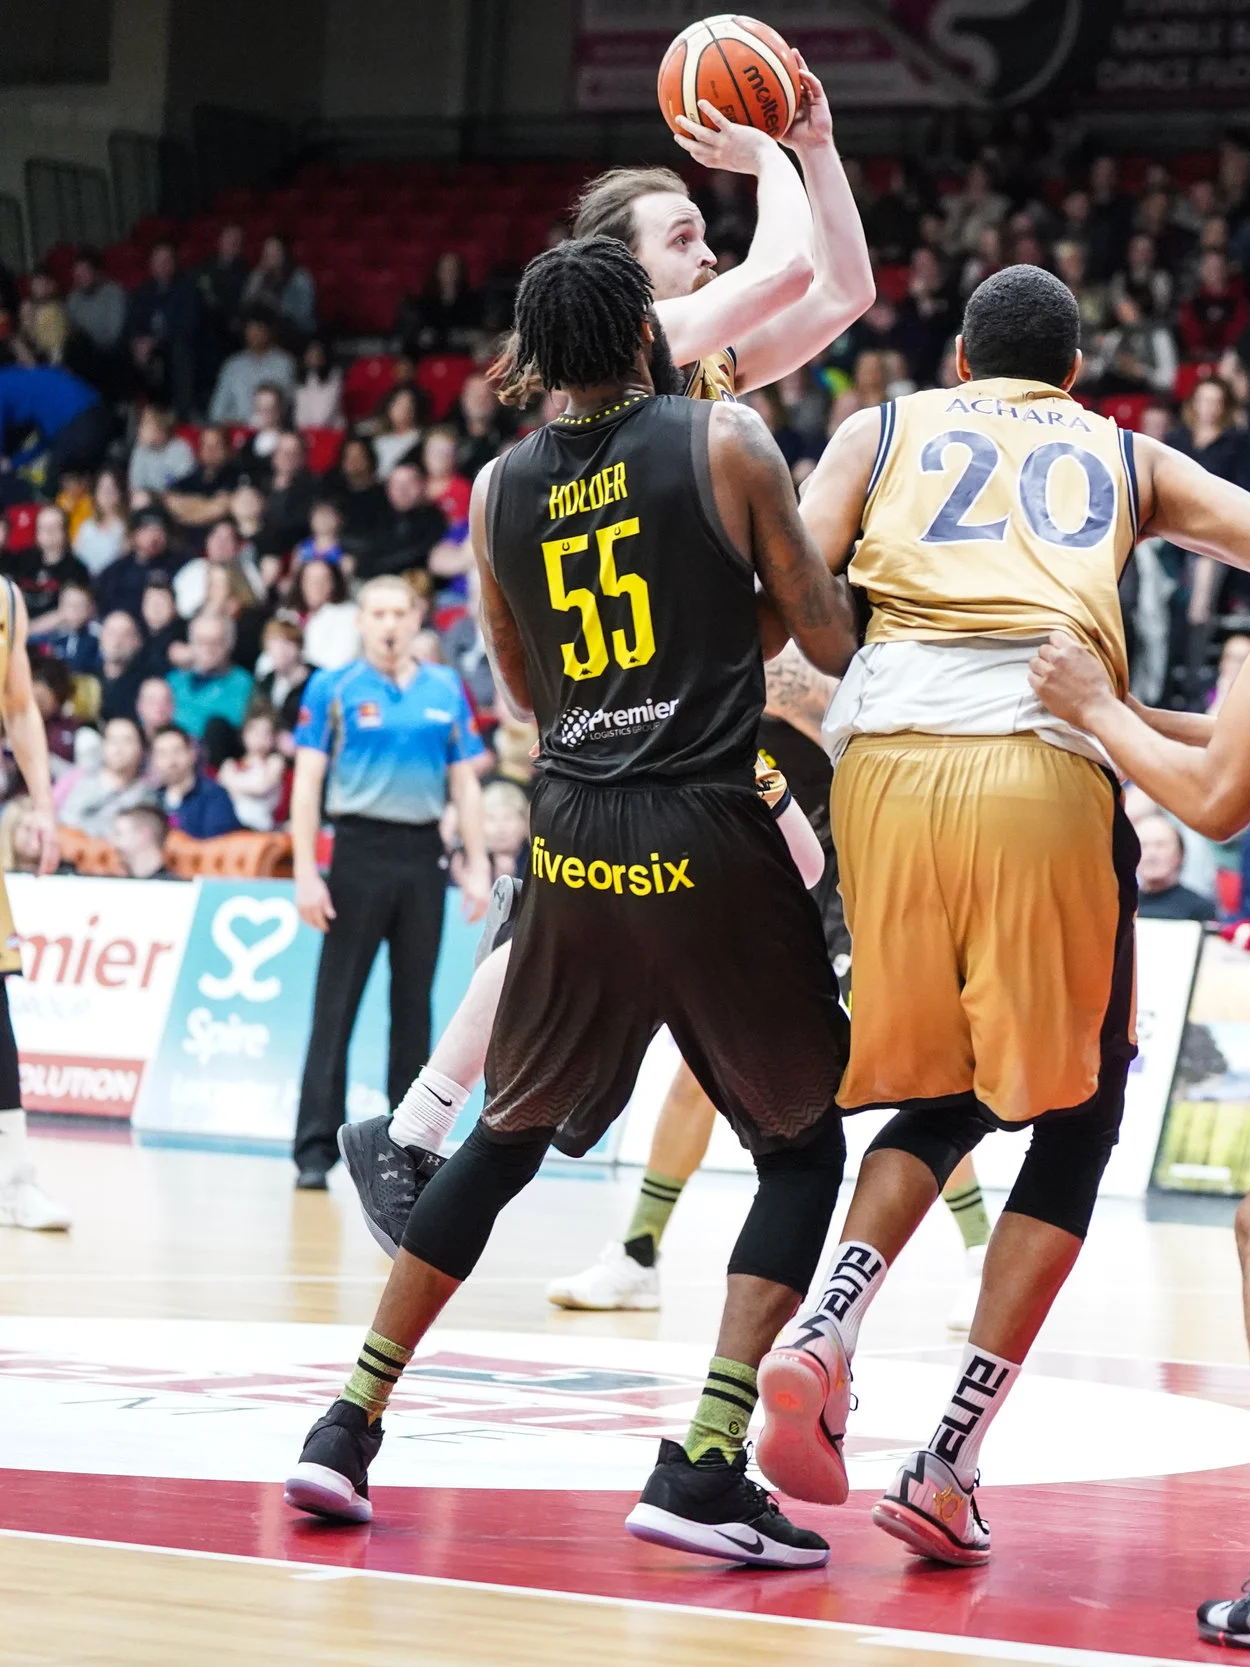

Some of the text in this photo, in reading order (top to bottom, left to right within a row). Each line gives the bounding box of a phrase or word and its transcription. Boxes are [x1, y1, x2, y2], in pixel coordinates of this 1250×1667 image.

[743, 65, 781, 137] molten
[945, 398, 1092, 433] ACHARA
[549, 461, 629, 520] HOLDER
[919, 429, 1117, 549] 20
[541, 516, 656, 682] 55
[587, 698, 680, 732] Premier
[589, 721, 662, 741] LOGISTICS GROUP
[532, 835, 696, 897] fiveorsix
[182, 1007, 270, 1066] Spire
[928, 1354, 1010, 1464] ELITE
